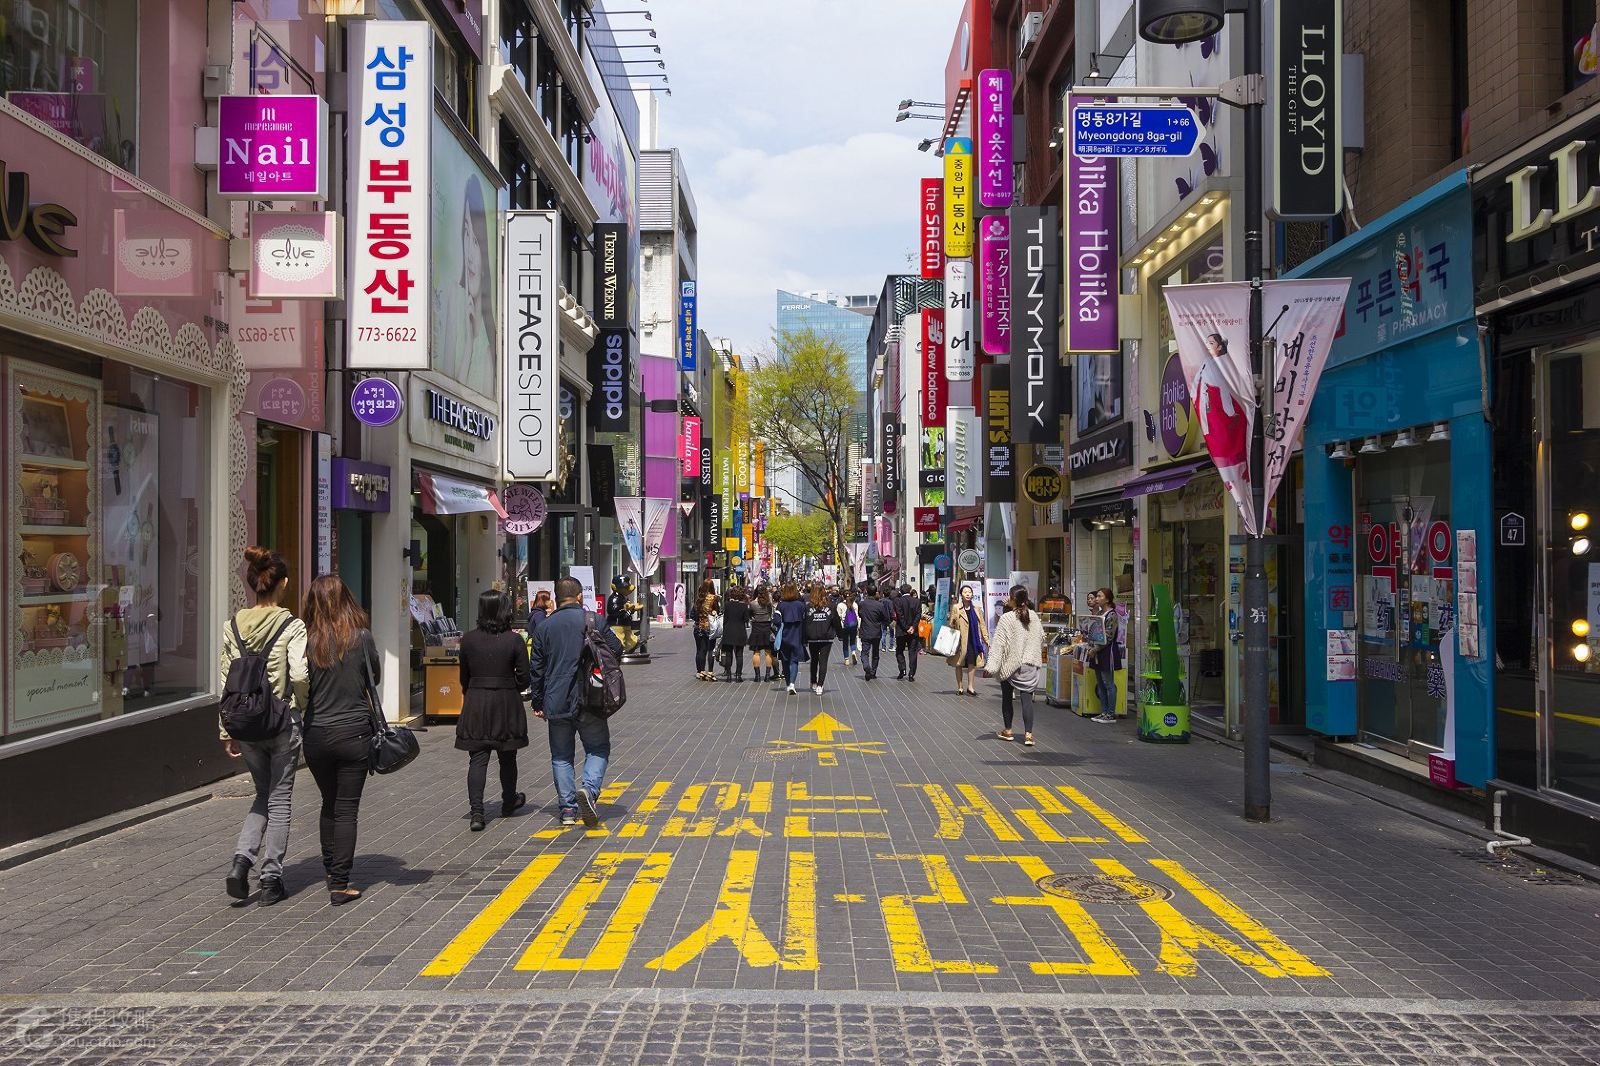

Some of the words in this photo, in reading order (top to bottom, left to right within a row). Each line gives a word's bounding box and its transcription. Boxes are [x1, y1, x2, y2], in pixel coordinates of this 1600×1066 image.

[1288, 65, 1297, 95] THE
[988, 77, 1005, 128] 제일사
[1288, 99, 1297, 135] GIFT
[1300, 25, 1325, 176] LLOYD
[1078, 112, 1142, 128] 명동8가길
[1078, 131, 1144, 143] Myeongdong
[1146, 131, 1183, 142] 8ga-gil
[1179, 118, 1190, 127] 66
[225, 136, 311, 165] Nail
[988, 133, 1006, 187] 옷수선
[244, 171, 294, 183] 네일아트
[925, 187, 940, 210] the
[272, 238, 316, 260] clue
[604, 231, 617, 274] TEENIE
[1078, 229, 1109, 322] Holika
[604, 274, 617, 320] WEENIE
[358, 327, 417, 342] 773-6622
[948, 291, 971, 351] 헤어
[1027, 218, 1044, 428] TONYMOLY
[1391, 302, 1449, 337] PHARMACY
[927, 345, 939, 371] new
[363, 387, 385, 399] 노정식
[602, 334, 623, 420] adidas
[1163, 380, 1185, 405] Holika
[356, 400, 396, 415] 성형외과
[927, 371, 939, 421] balance
[430, 389, 495, 441] THEFACESHOP
[1162, 406, 1177, 431] Holi
[685, 419, 698, 455] banila
[1068, 437, 1119, 470] TONYMOLY
[702, 448, 711, 485] GUESS
[722, 457, 730, 487] NATURE
[885, 423, 894, 491] GIORDANO
[954, 419, 971, 496] innisfree
[710, 502, 718, 545] ARITAUM
[1507, 528, 1518, 541] 47
[1367, 521, 1402, 595] 약
